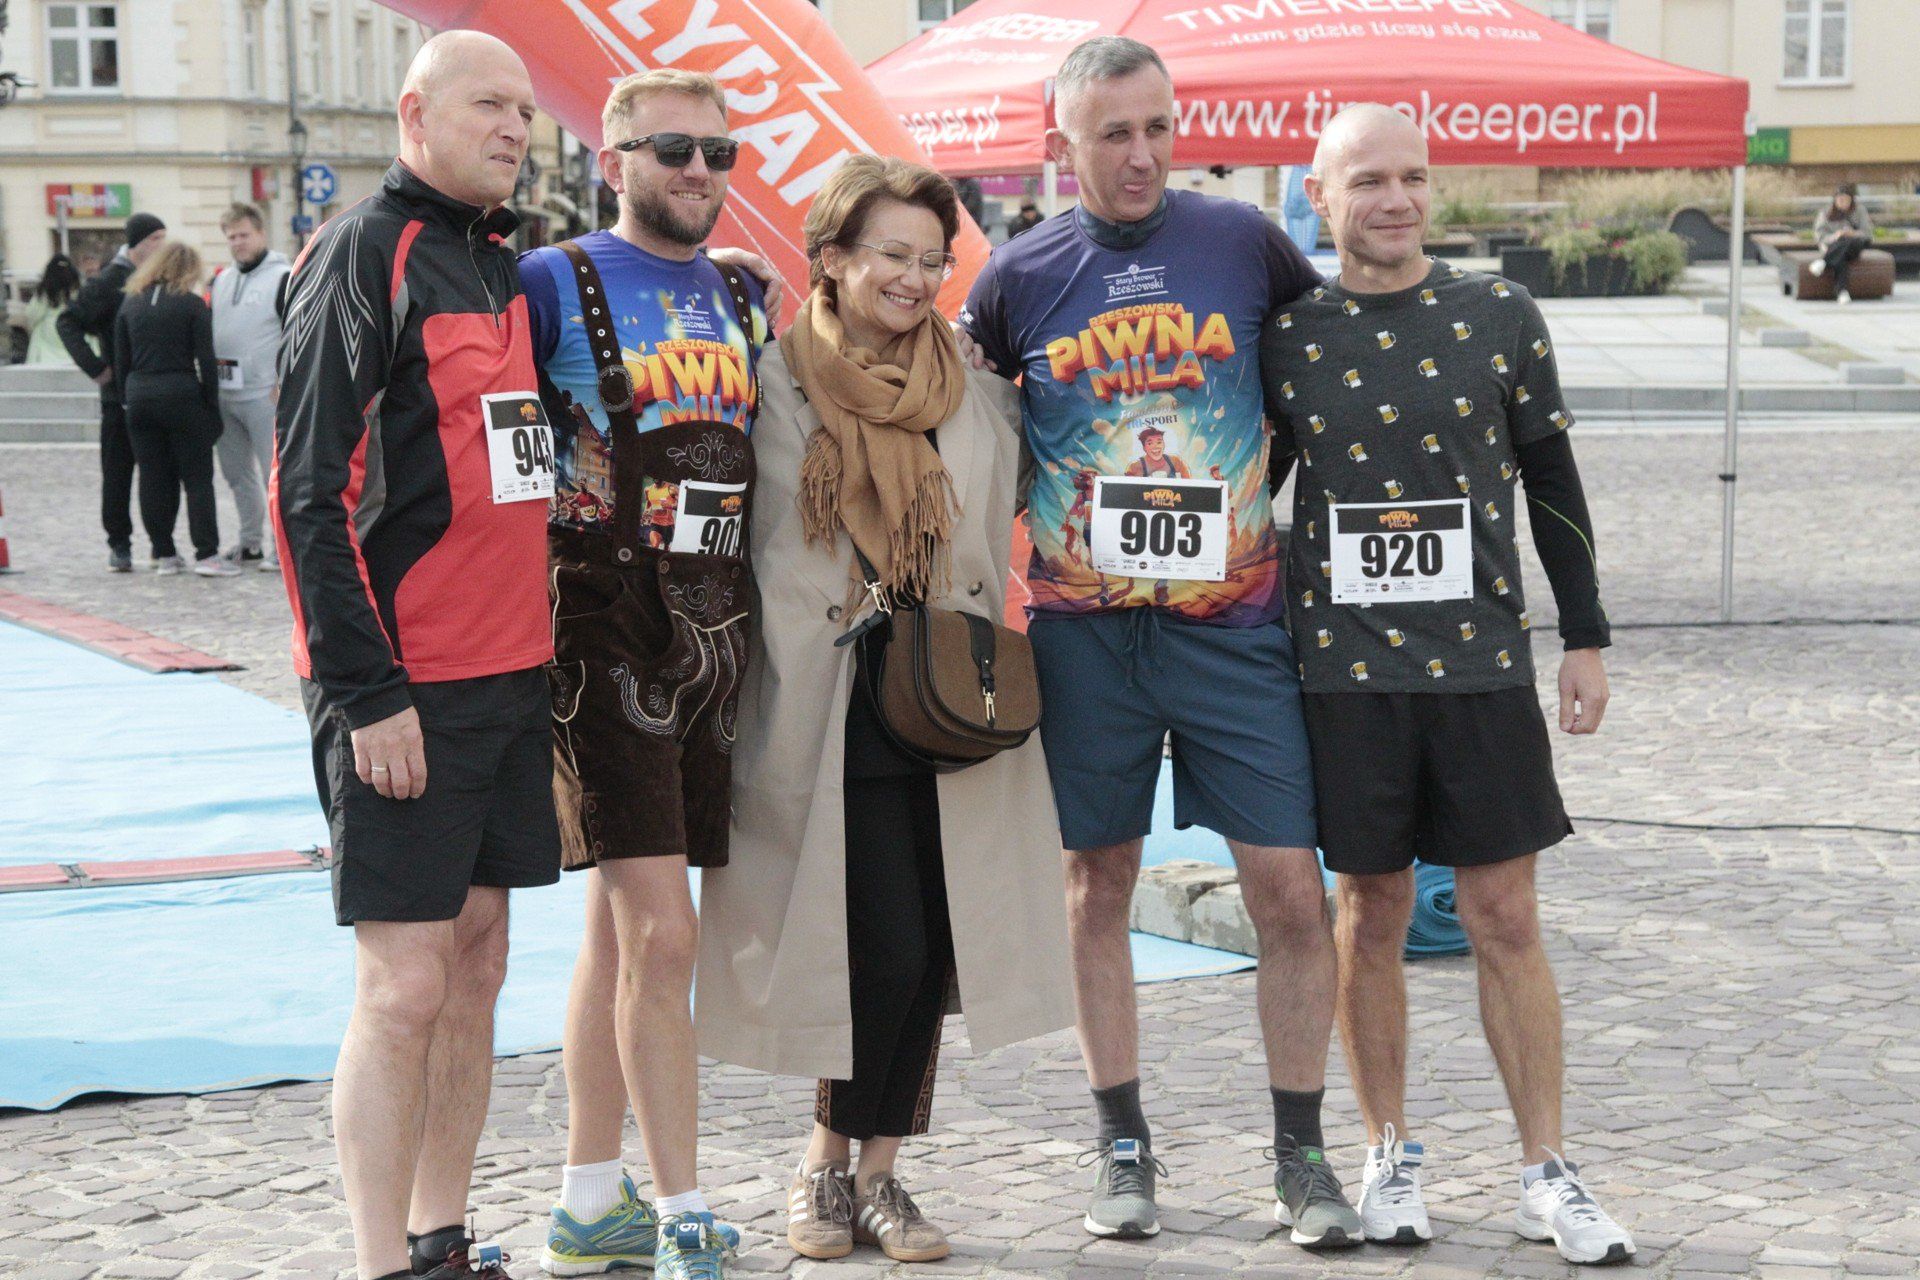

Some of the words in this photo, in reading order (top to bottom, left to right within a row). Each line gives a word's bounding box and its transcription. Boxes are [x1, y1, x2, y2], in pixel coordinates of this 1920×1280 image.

[1292, 22, 1366, 42] gdzie
[1370, 20, 1436, 39] liczy
[1441, 21, 1481, 40] się
[1484, 25, 1542, 42] czas
[1107, 277, 1164, 297] Rzeszowski
[1088, 302, 1186, 327] RZESZOWSKA
[1046, 312, 1236, 382] PIWNA
[623, 351, 757, 404] PIWN
[1088, 350, 1206, 400] MILA
[1120, 511, 1202, 558] 903
[1360, 532, 1443, 578] 920
